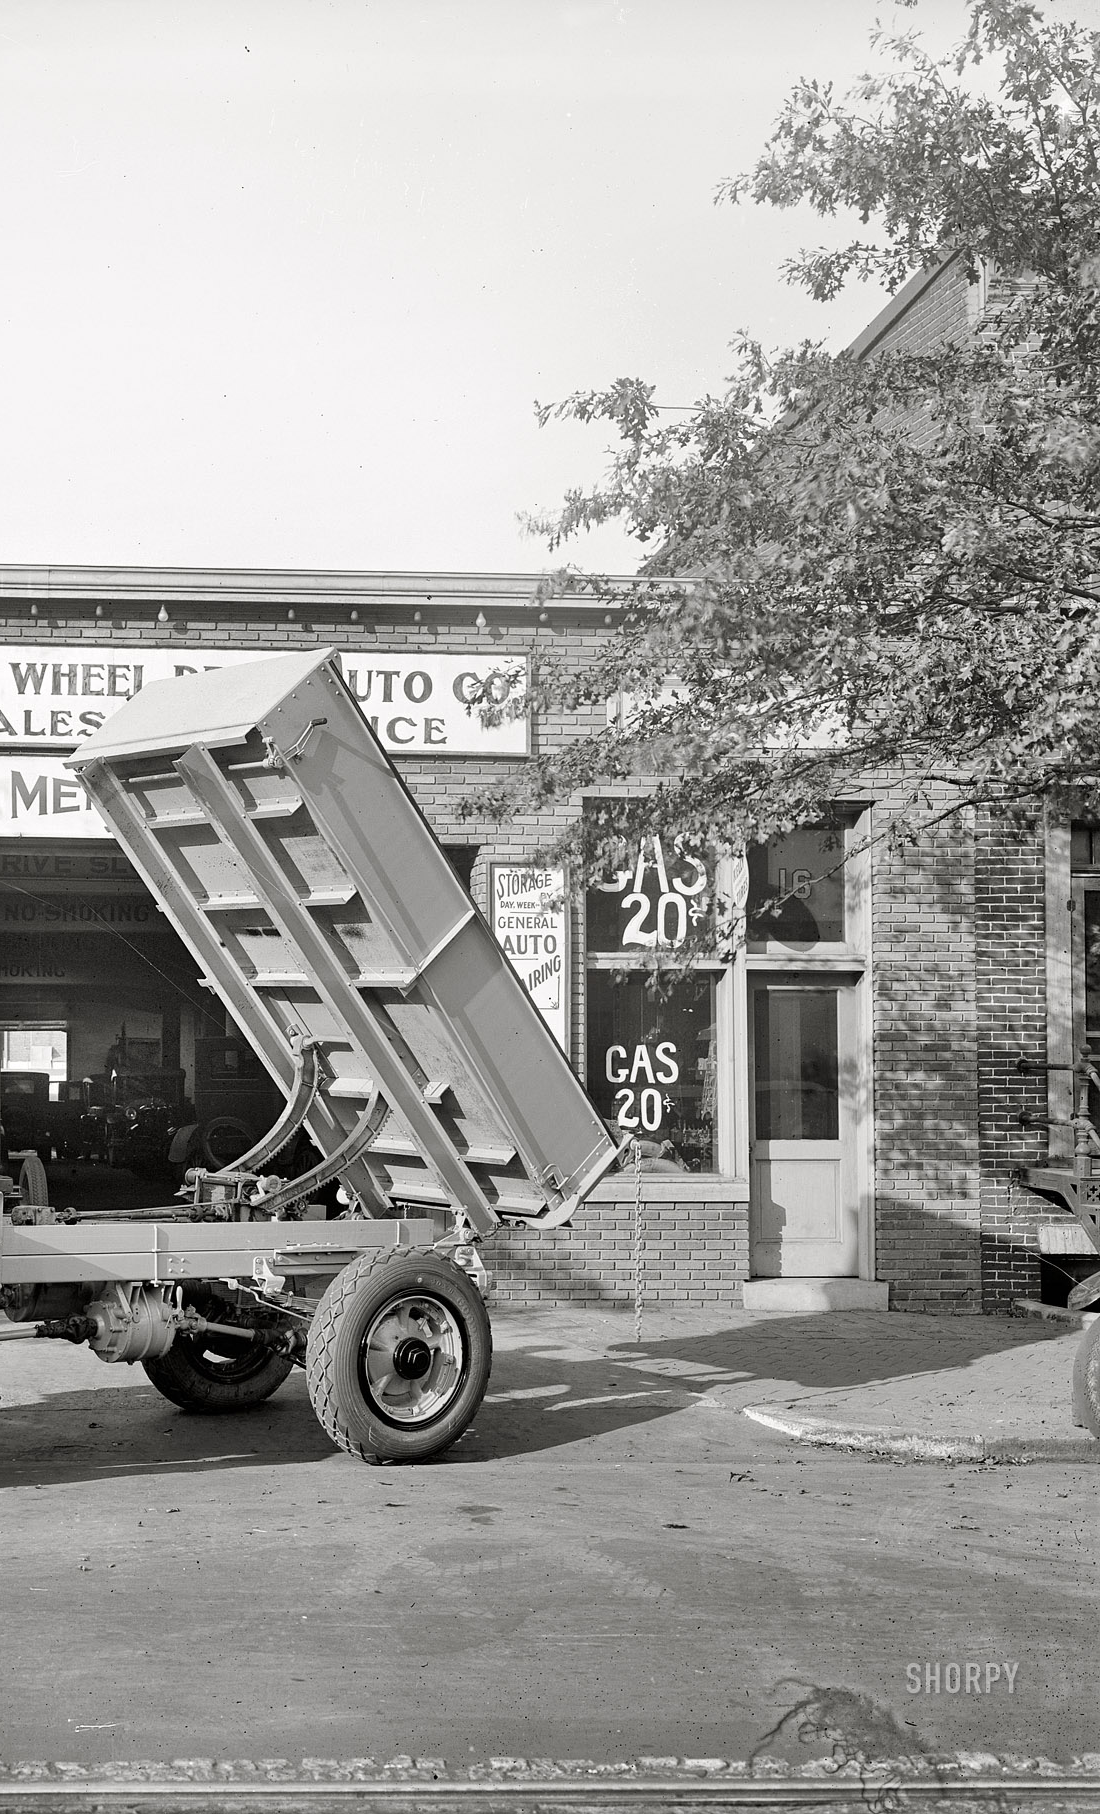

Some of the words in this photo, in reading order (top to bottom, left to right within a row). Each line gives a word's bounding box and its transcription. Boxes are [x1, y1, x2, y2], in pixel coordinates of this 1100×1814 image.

[346, 669, 433, 704] UTO
[89, 855, 128, 876] SL
[497, 872, 553, 900] STORAGE
[778, 868, 813, 900] 16
[497, 916, 559, 930] GENERAL
[502, 934, 558, 956] AUTO
[604, 1041, 680, 1085] GAS
